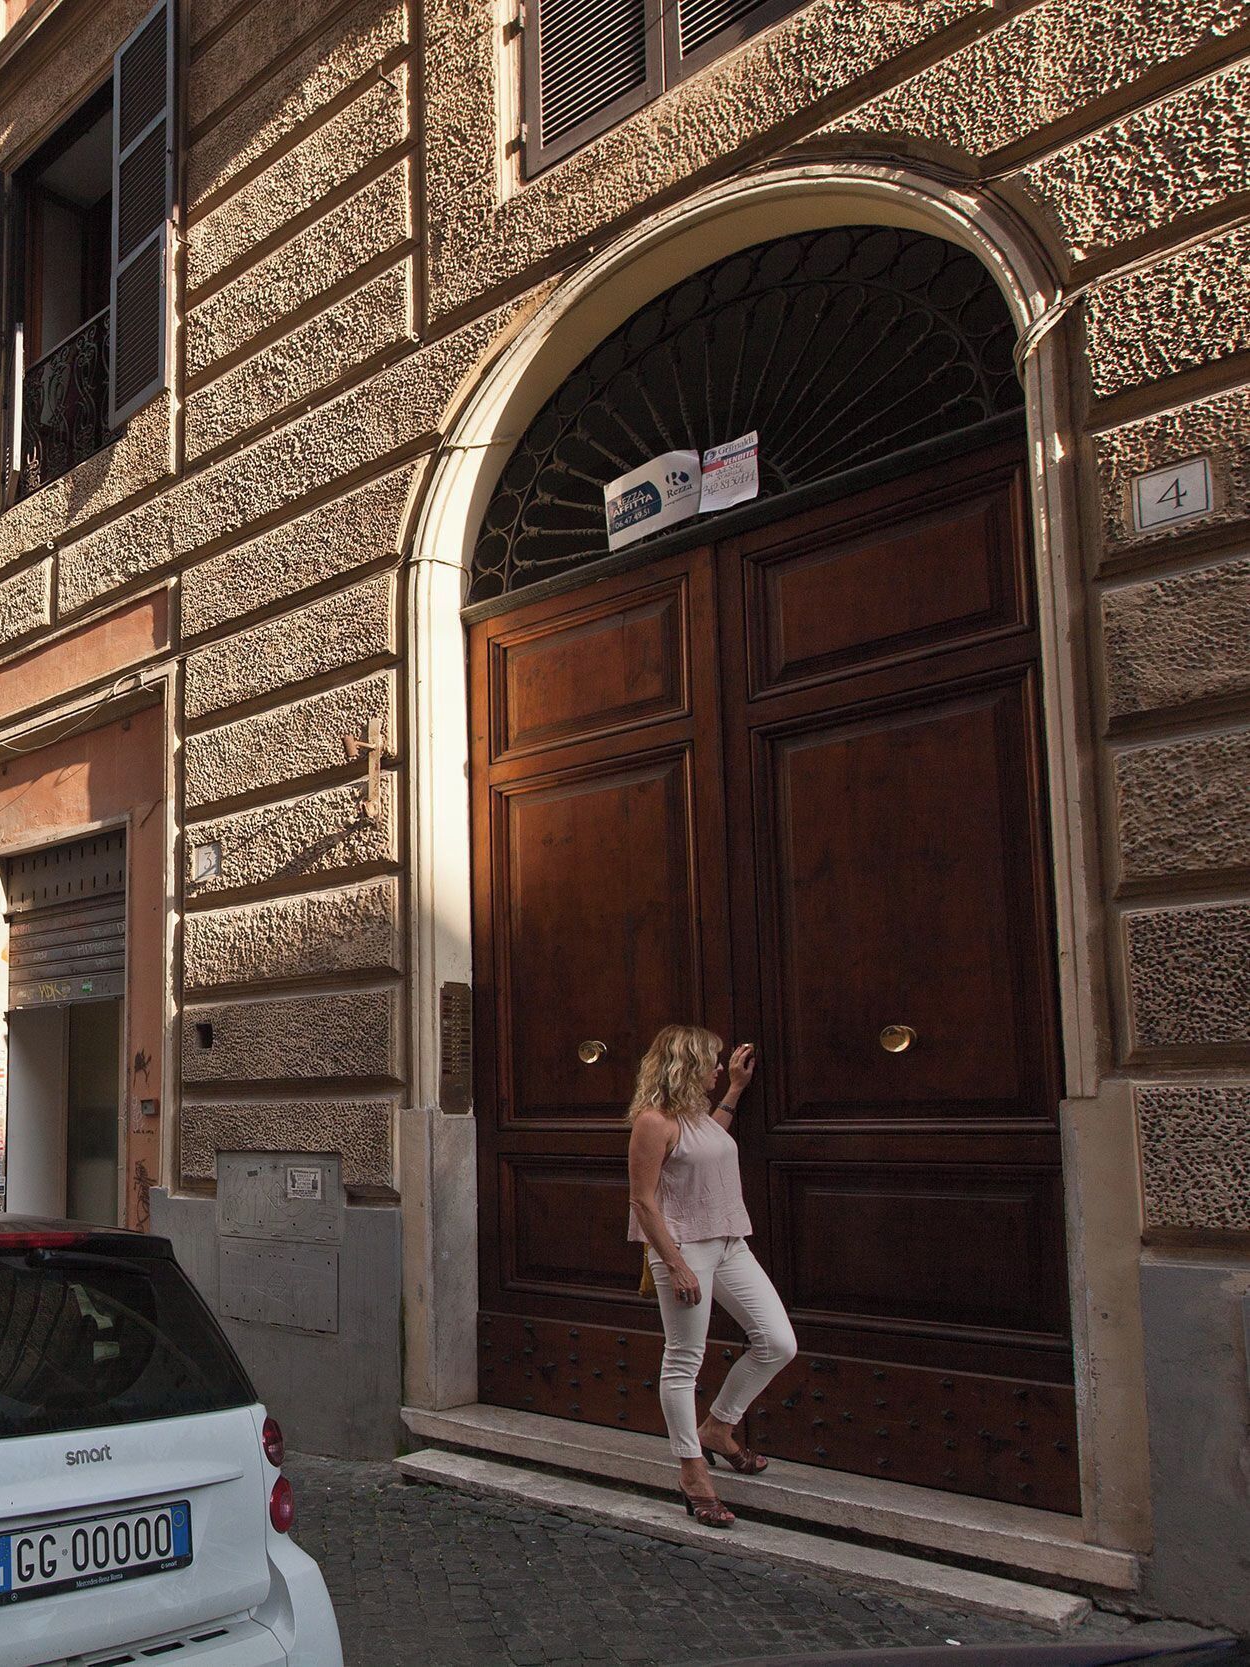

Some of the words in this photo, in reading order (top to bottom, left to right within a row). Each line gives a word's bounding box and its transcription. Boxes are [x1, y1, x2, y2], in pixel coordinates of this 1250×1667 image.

[718, 435, 754, 455] Grimaldi
[723, 449, 755, 466] VENDITA
[616, 490, 644, 508] REZZA
[666, 483, 693, 499] Rezza
[1155, 478, 1187, 509] 4
[613, 493, 653, 518] AFFITTA
[204, 852, 213, 870] 3
[65, 1444, 112, 1466] smart
